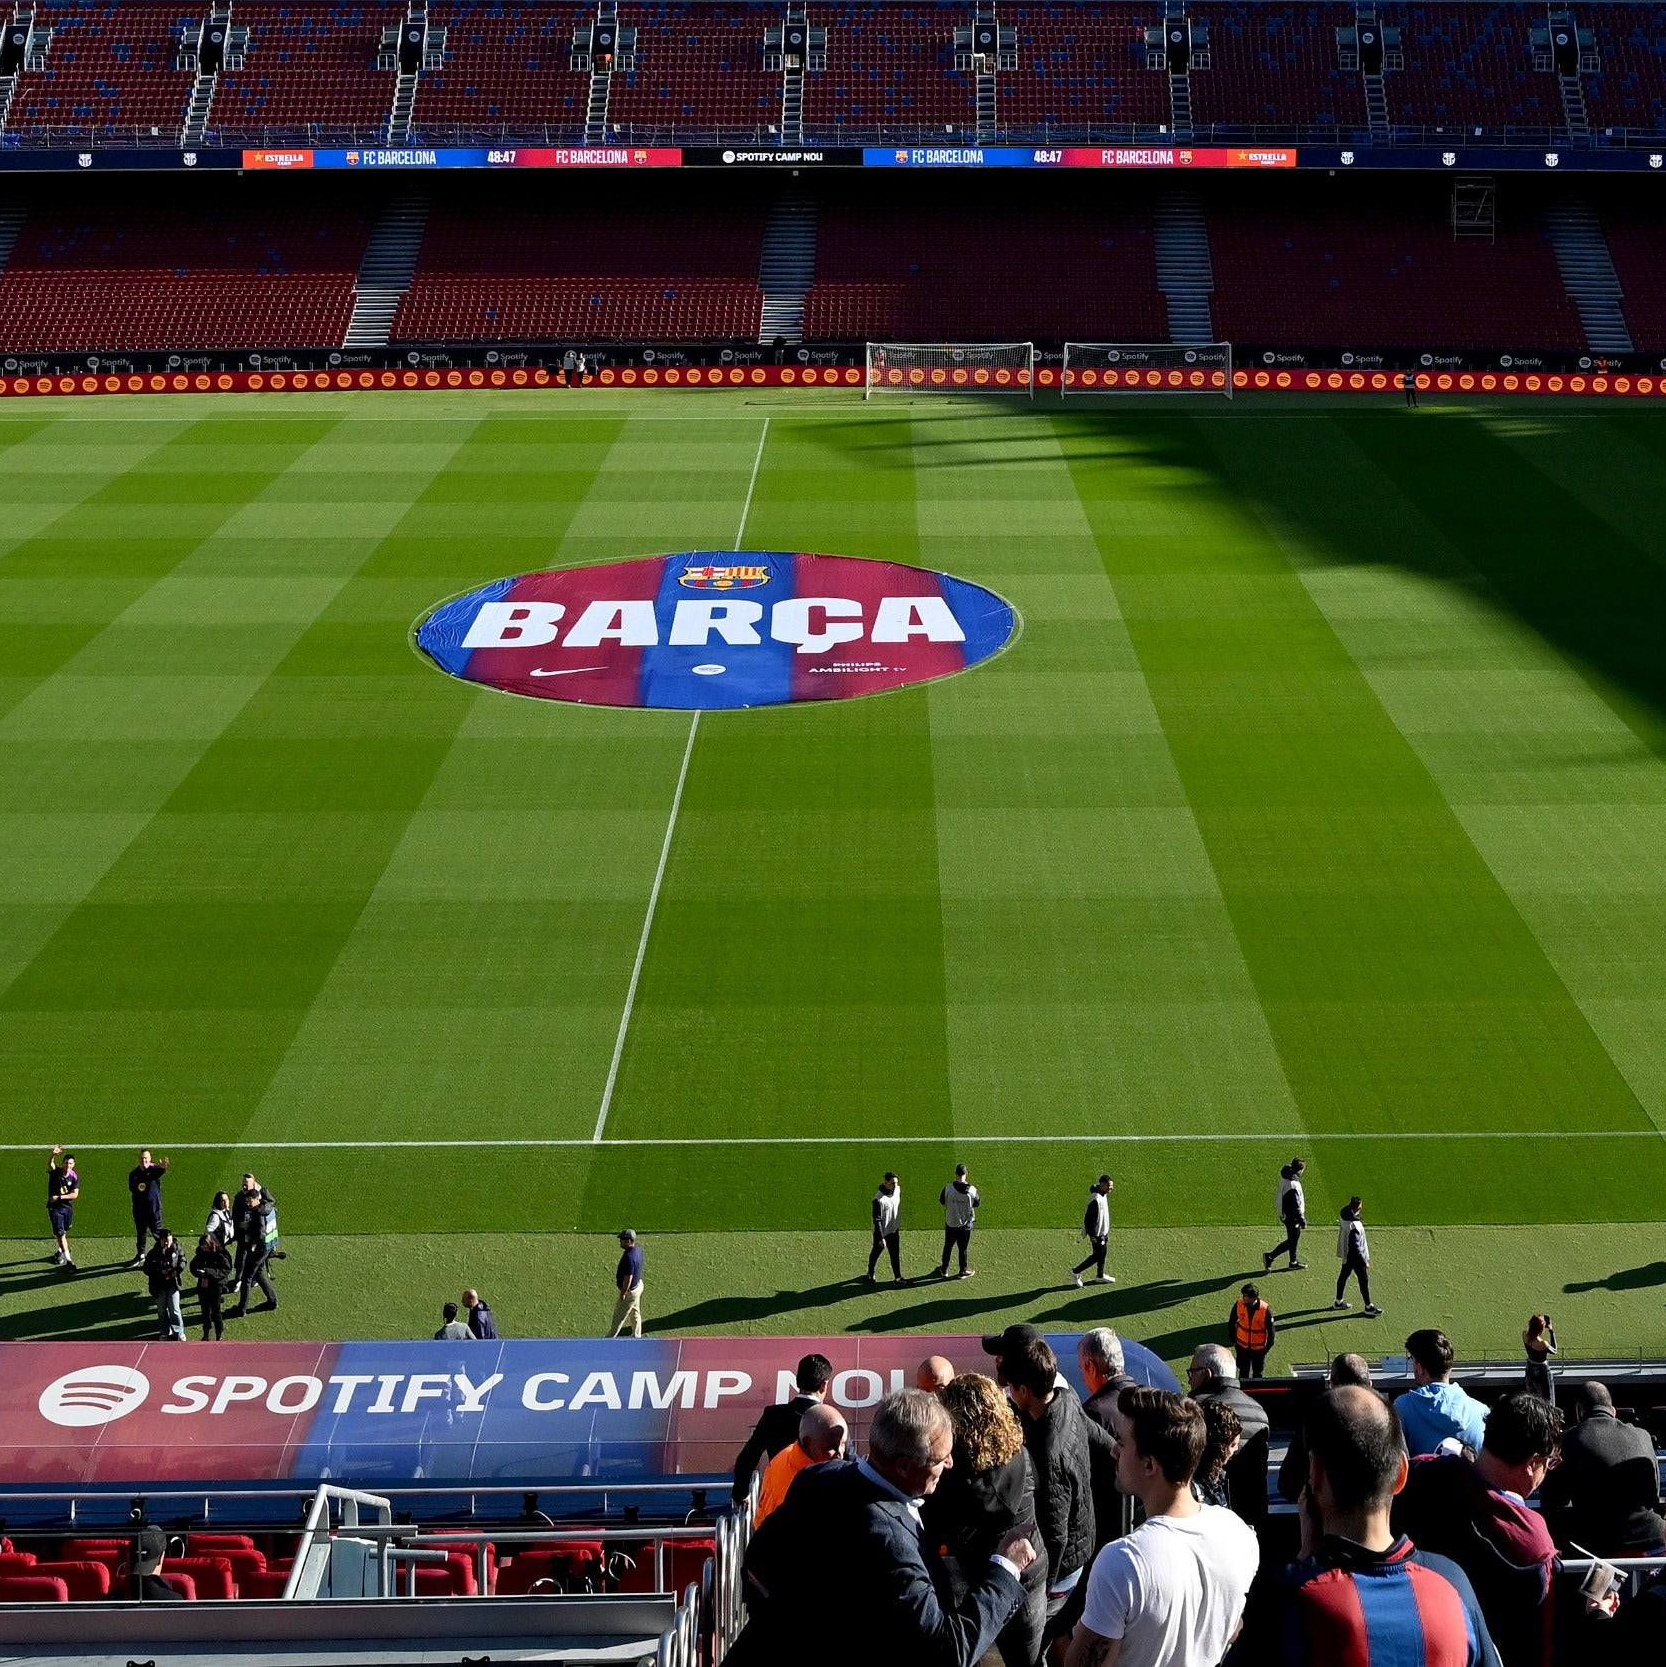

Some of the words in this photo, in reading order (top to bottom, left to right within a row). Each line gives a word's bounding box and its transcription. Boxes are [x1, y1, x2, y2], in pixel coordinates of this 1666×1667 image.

[264, 154, 304, 162] ESTRELLA
[364, 151, 375, 164] FC
[378, 151, 436, 164] BARCELONA
[488, 151, 515, 163] 48:47
[557, 151, 568, 163] FC
[571, 150, 628, 163] BARCELONA
[737, 153, 774, 161] SPOTIFY
[776, 153, 805, 161] CAMP
[806, 153, 822, 161] NOU
[913, 150, 924, 163] FC
[927, 150, 983, 163] BARCELONA
[1034, 151, 1062, 162] 48:47
[1102, 151, 1114, 163] FC
[1117, 151, 1173, 164] BARCELONA
[1248, 153, 1287, 161] ESTRELLA
[264, 356, 291, 364] Spotify
[422, 354, 449, 362] Spotify
[584, 352, 606, 360] potify
[1198, 353, 1226, 361] Spotify
[1277, 354, 1305, 362] Spotify
[1435, 356, 1462, 364] Spotify
[20, 360, 48, 368] Spotify
[101, 359, 130, 367] Spotify
[183, 358, 212, 366] Spotify
[1514, 358, 1542, 366] Spotify
[461, 597, 966, 653] BARÇA
[161, 1373, 504, 1415] SPOTIFY
[522, 1370, 753, 1411] CAMP
